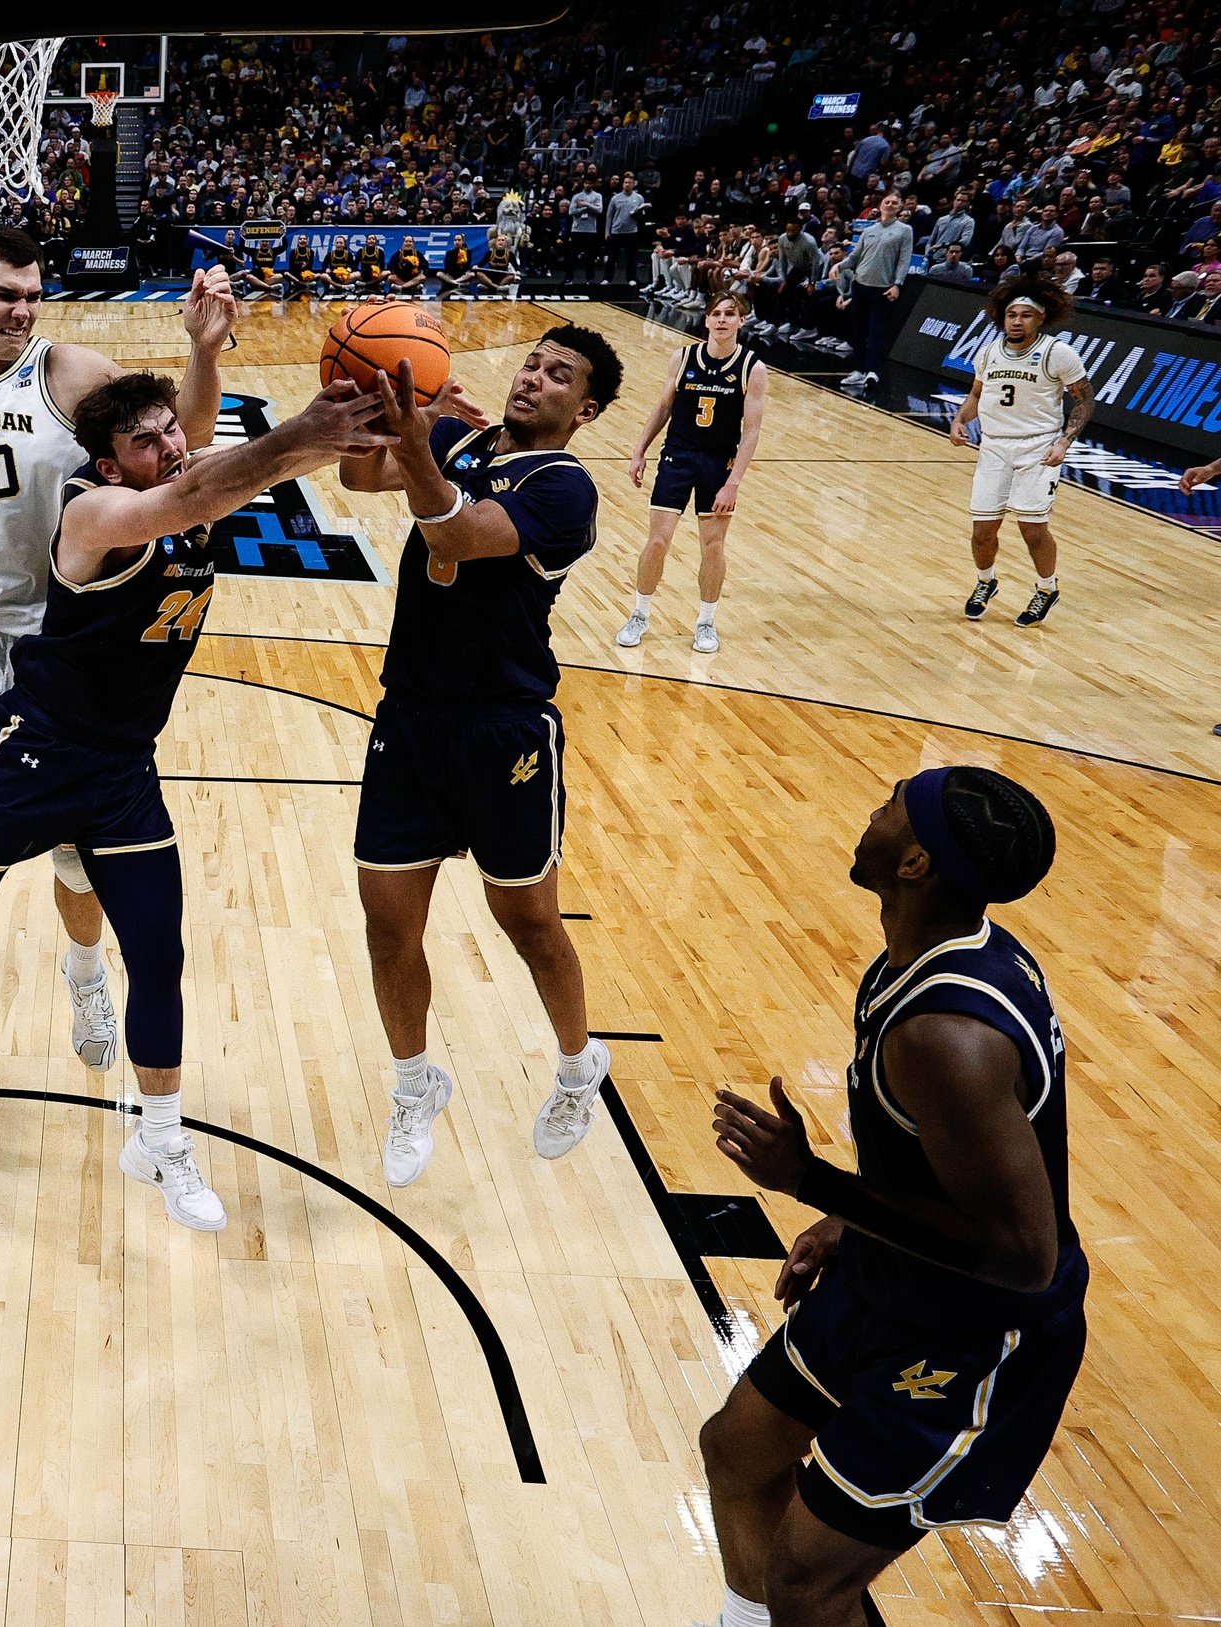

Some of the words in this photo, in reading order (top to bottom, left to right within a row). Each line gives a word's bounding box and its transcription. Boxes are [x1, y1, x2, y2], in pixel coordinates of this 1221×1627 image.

[821, 96, 847, 105] MARCH
[823, 104, 858, 114] MADNESS
[245, 226, 281, 235] DEFENSE
[82, 250, 113, 259] MARCH
[85, 259, 126, 269] MADNESS
[919, 316, 946, 337] DRAW
[941, 322, 961, 341] THE
[1094, 346, 1145, 405] A
[987, 369, 1038, 383] MICHIGAN
[999, 384, 1016, 407] 3
[696, 396, 717, 428] 3
[140, 585, 215, 643] 24
